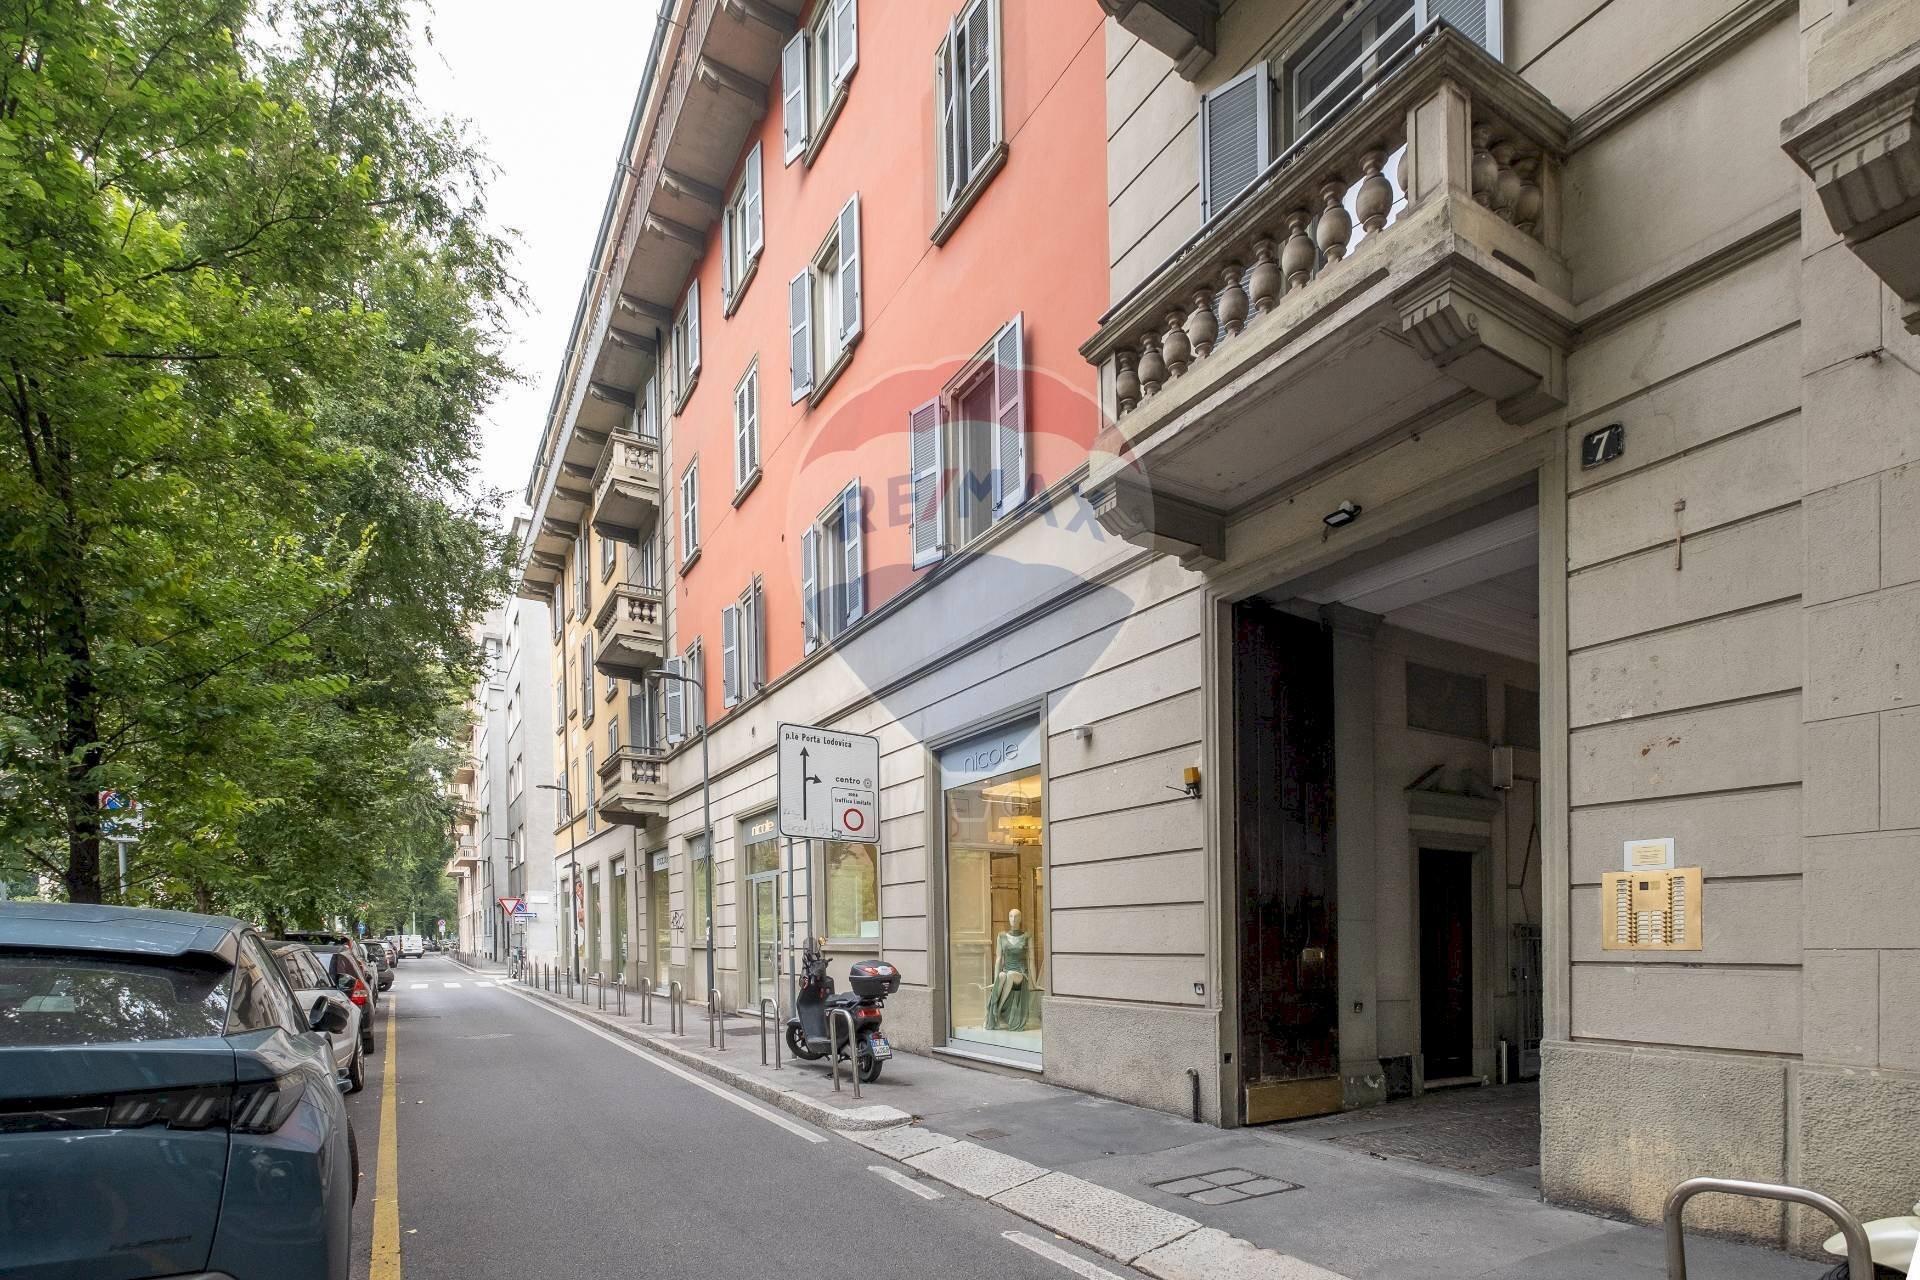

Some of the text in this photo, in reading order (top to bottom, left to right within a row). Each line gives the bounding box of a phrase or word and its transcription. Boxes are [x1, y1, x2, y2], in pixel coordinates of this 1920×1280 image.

[1592, 430, 1610, 462] 7
[785, 732, 852, 748] p.le Porta Lodovica
[964, 740, 1019, 774] nicole
[835, 775, 861, 785] centro
[751, 819, 775, 837] nicole
